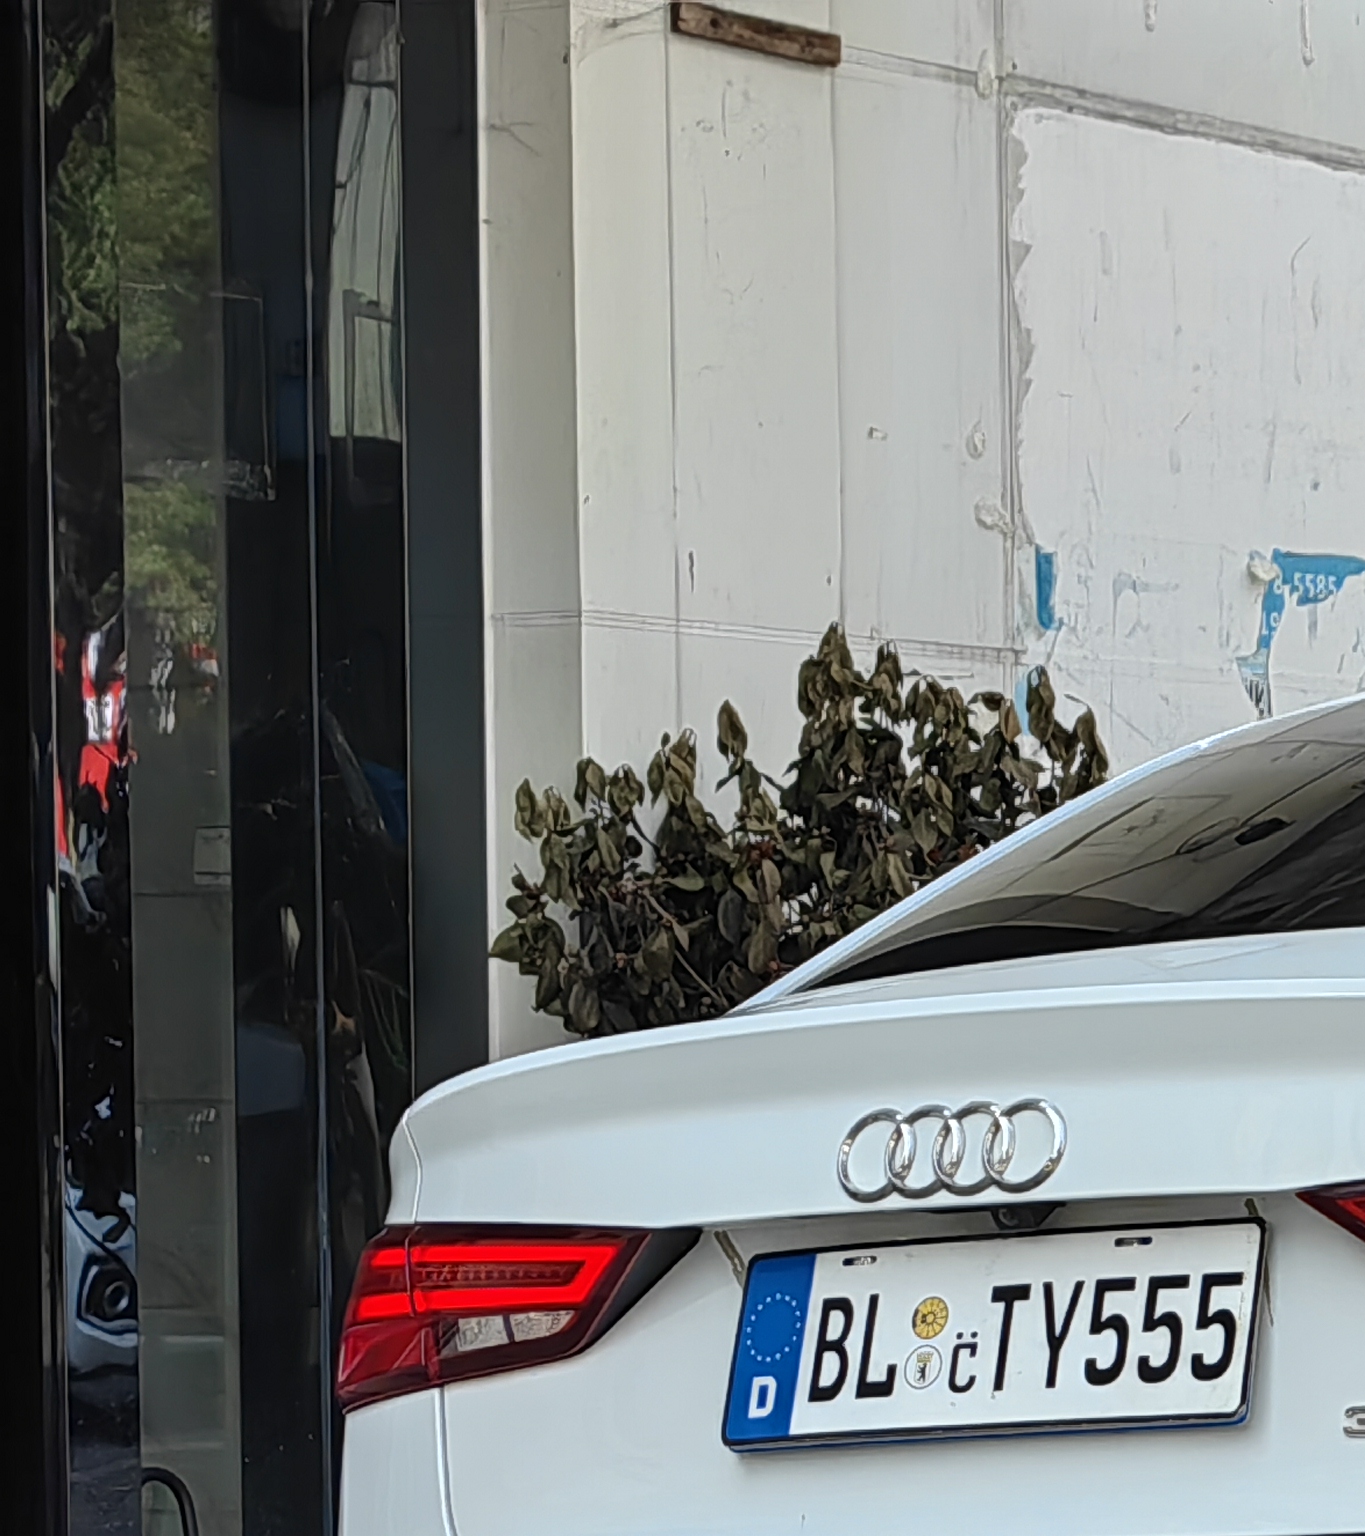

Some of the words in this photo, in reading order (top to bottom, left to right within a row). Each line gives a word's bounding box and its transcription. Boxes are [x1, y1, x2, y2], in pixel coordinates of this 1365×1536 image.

[808, 1293, 898, 1402] BL
[990, 1271, 1245, 1393] TY555
[747, 1375, 778, 1419] D
